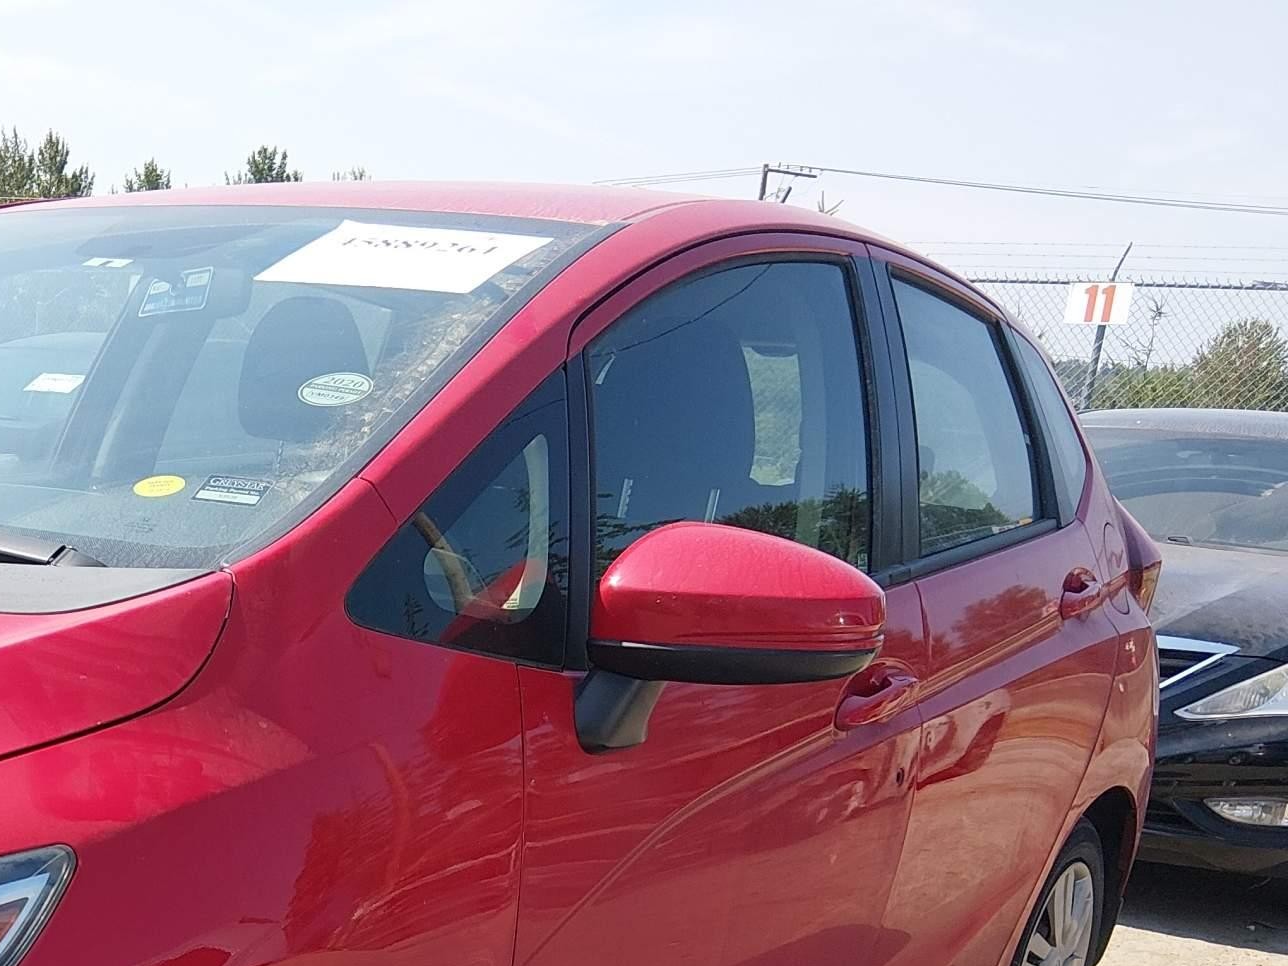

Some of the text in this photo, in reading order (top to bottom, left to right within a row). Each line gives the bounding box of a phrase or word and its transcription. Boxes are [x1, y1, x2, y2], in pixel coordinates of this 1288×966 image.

[1083, 284, 1117, 323] 11
[323, 376, 365, 389] 2020
[209, 477, 266, 491] GREYSTAR
